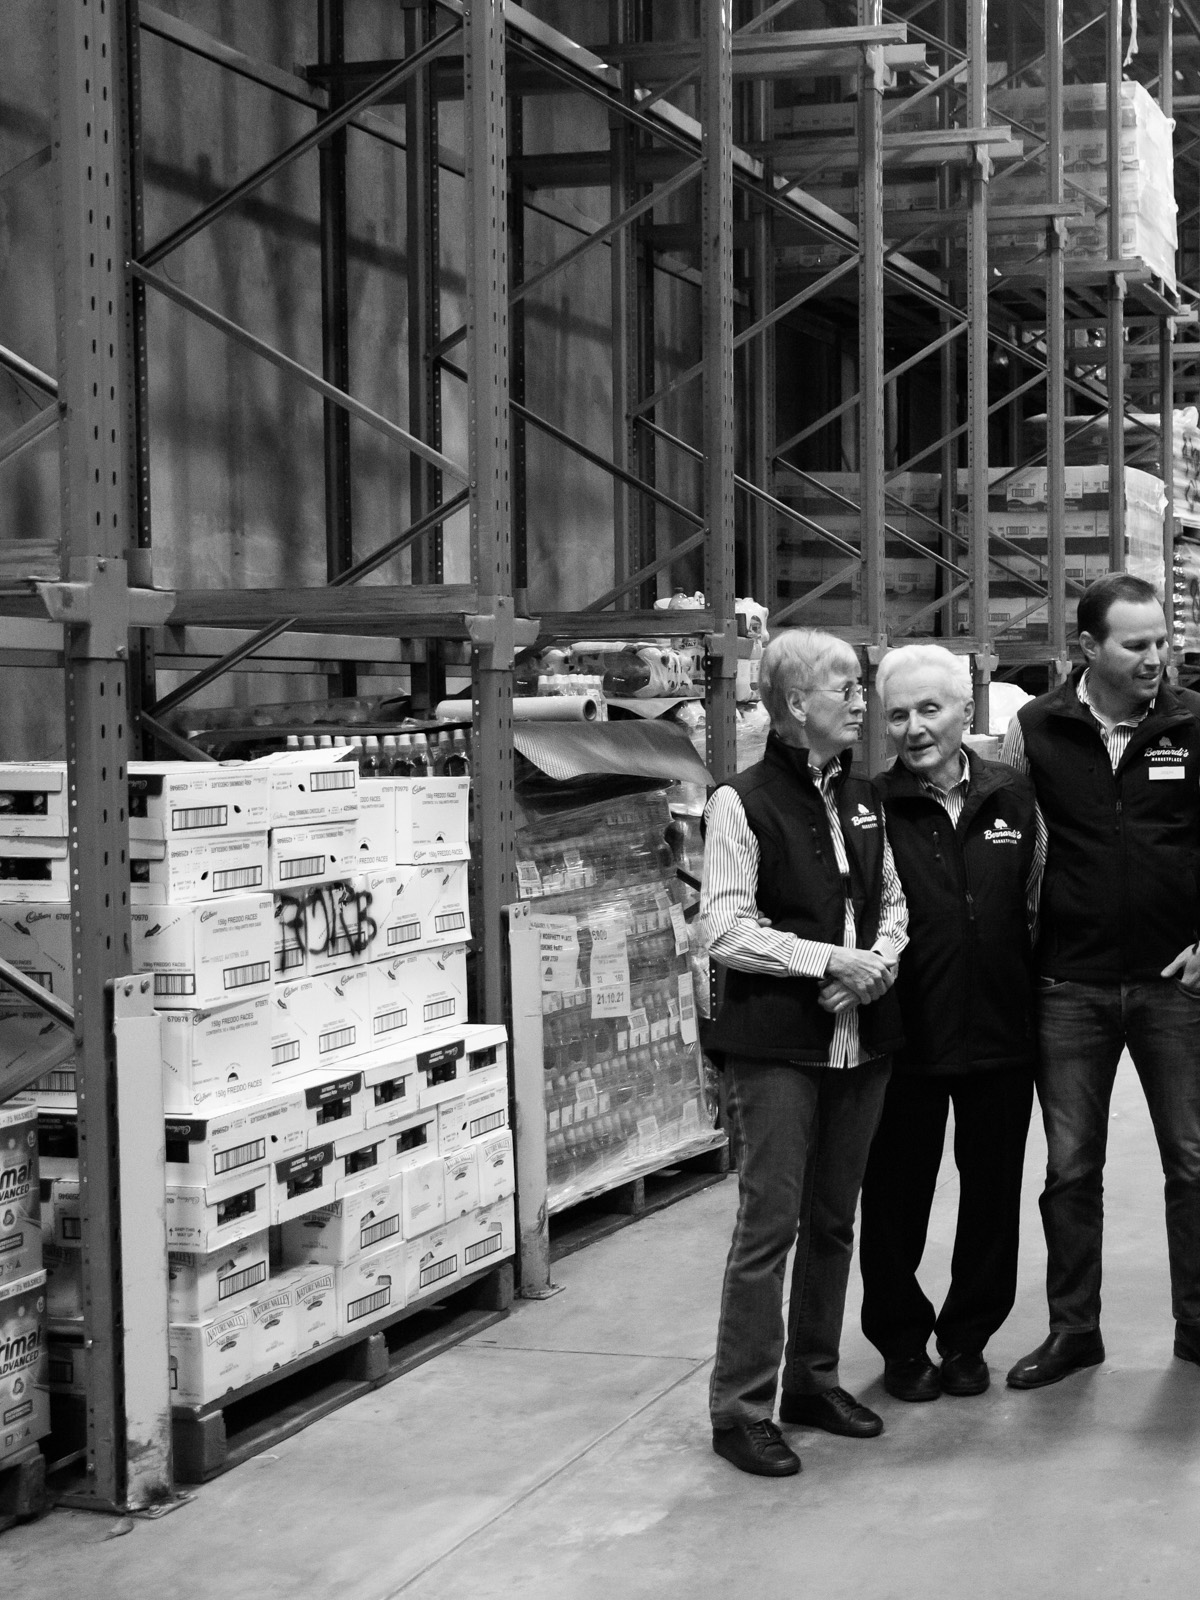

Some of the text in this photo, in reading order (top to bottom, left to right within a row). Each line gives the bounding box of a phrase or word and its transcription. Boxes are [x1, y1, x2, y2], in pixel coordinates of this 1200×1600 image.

[1144, 747, 1189, 758] Bernardi's
[26, 911, 51, 924] Cadbury
[200, 910, 218, 923] Cadbury
[217, 918, 227, 926] 150g
[227, 915, 244, 923] FREDDO
[596, 992, 624, 1005] 21.10.21
[221, 1016, 240, 1025] FREDDO
[240, 1012, 254, 1020] FACES
[215, 1090, 226, 1098] 150g
[227, 1082, 247, 1094] FREDDO
[247, 1079, 262, 1088] FACES
[313, 1275, 333, 1290] VALLEY
[252, 1292, 291, 1318] NATURE VALLEY
[206, 1315, 247, 1340] NATURE VALLEY
